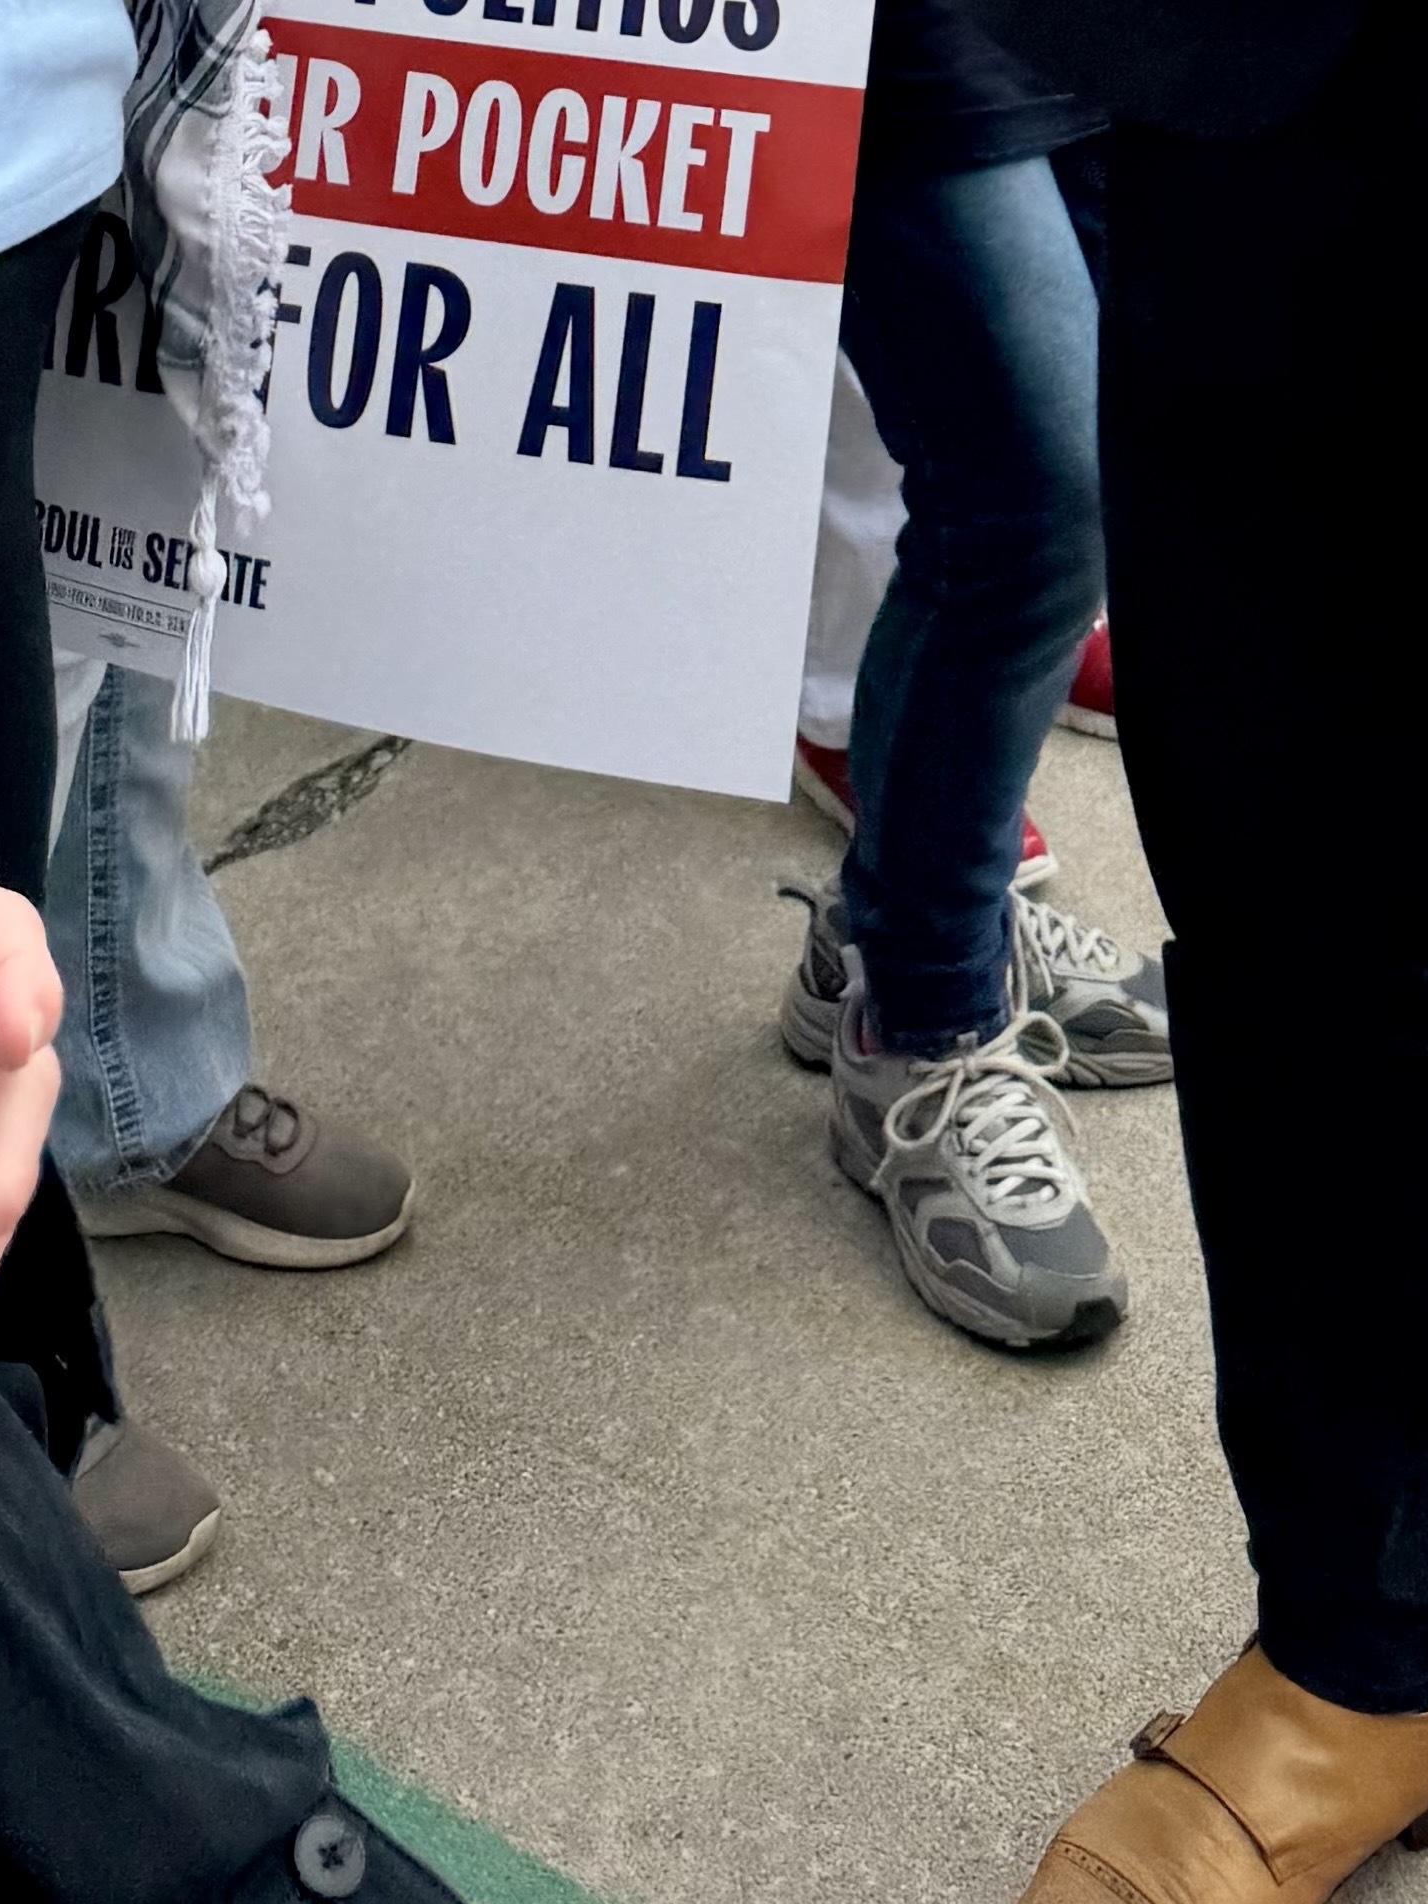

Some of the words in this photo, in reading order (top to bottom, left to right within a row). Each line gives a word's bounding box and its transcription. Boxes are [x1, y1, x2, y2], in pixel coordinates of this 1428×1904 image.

[393, 69, 771, 238] POCKET
[516, 281, 732, 483] ALL
[109, 545, 134, 570] US
[142, 532, 272, 611] SETE
